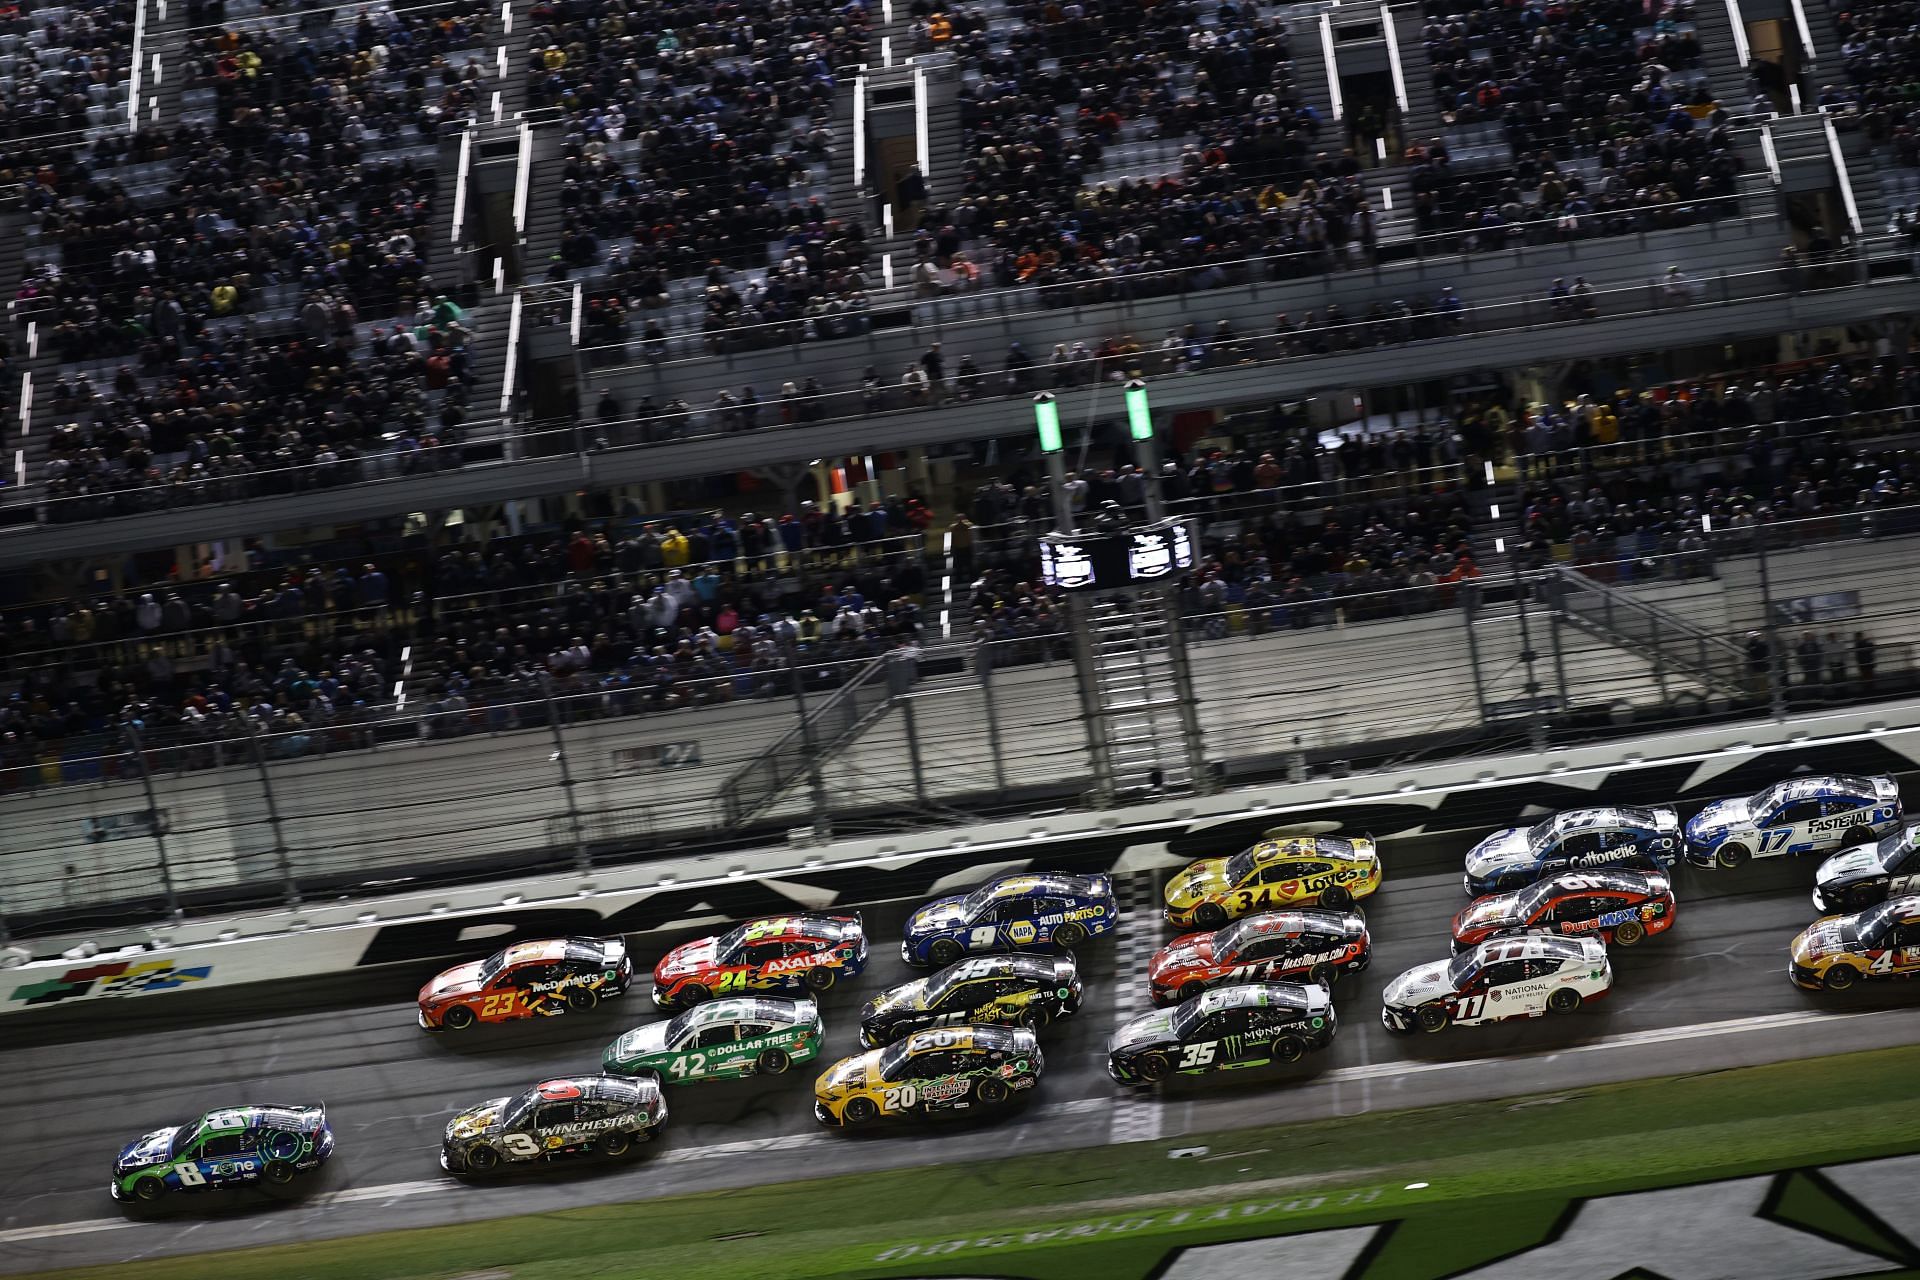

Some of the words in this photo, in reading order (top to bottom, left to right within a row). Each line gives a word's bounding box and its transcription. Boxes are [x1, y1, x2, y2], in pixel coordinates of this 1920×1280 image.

[1755, 827, 1795, 857] 17
[1569, 842, 1638, 869] Cottonelle
[1235, 888, 1273, 914] 34
[1039, 913, 1064, 926] AUTO
[1063, 910, 1094, 923] PARTS
[969, 927, 997, 950] 9
[1013, 925, 1033, 938] NAPA
[767, 948, 837, 974] AXALTA
[1869, 949, 1894, 974] 4
[532, 973, 600, 993] McDonald's
[719, 970, 748, 994] 24
[1042, 990, 1054, 998] TEA
[1505, 983, 1549, 997] NATIONAL
[481, 992, 516, 1017] 23
[1456, 995, 1486, 1021] 11
[716, 1039, 764, 1056] DOLLAR
[763, 1032, 793, 1047] TREE
[1179, 1040, 1219, 1068] 35
[668, 1053, 708, 1078] 42
[883, 1086, 918, 1111] 20
[922, 1079, 972, 1095] INTERSTATE
[922, 1087, 968, 1100] BATTERIES
[536, 1113, 636, 1138] WINCHESTER
[501, 1133, 541, 1157] 3
[173, 1161, 208, 1187] 8
